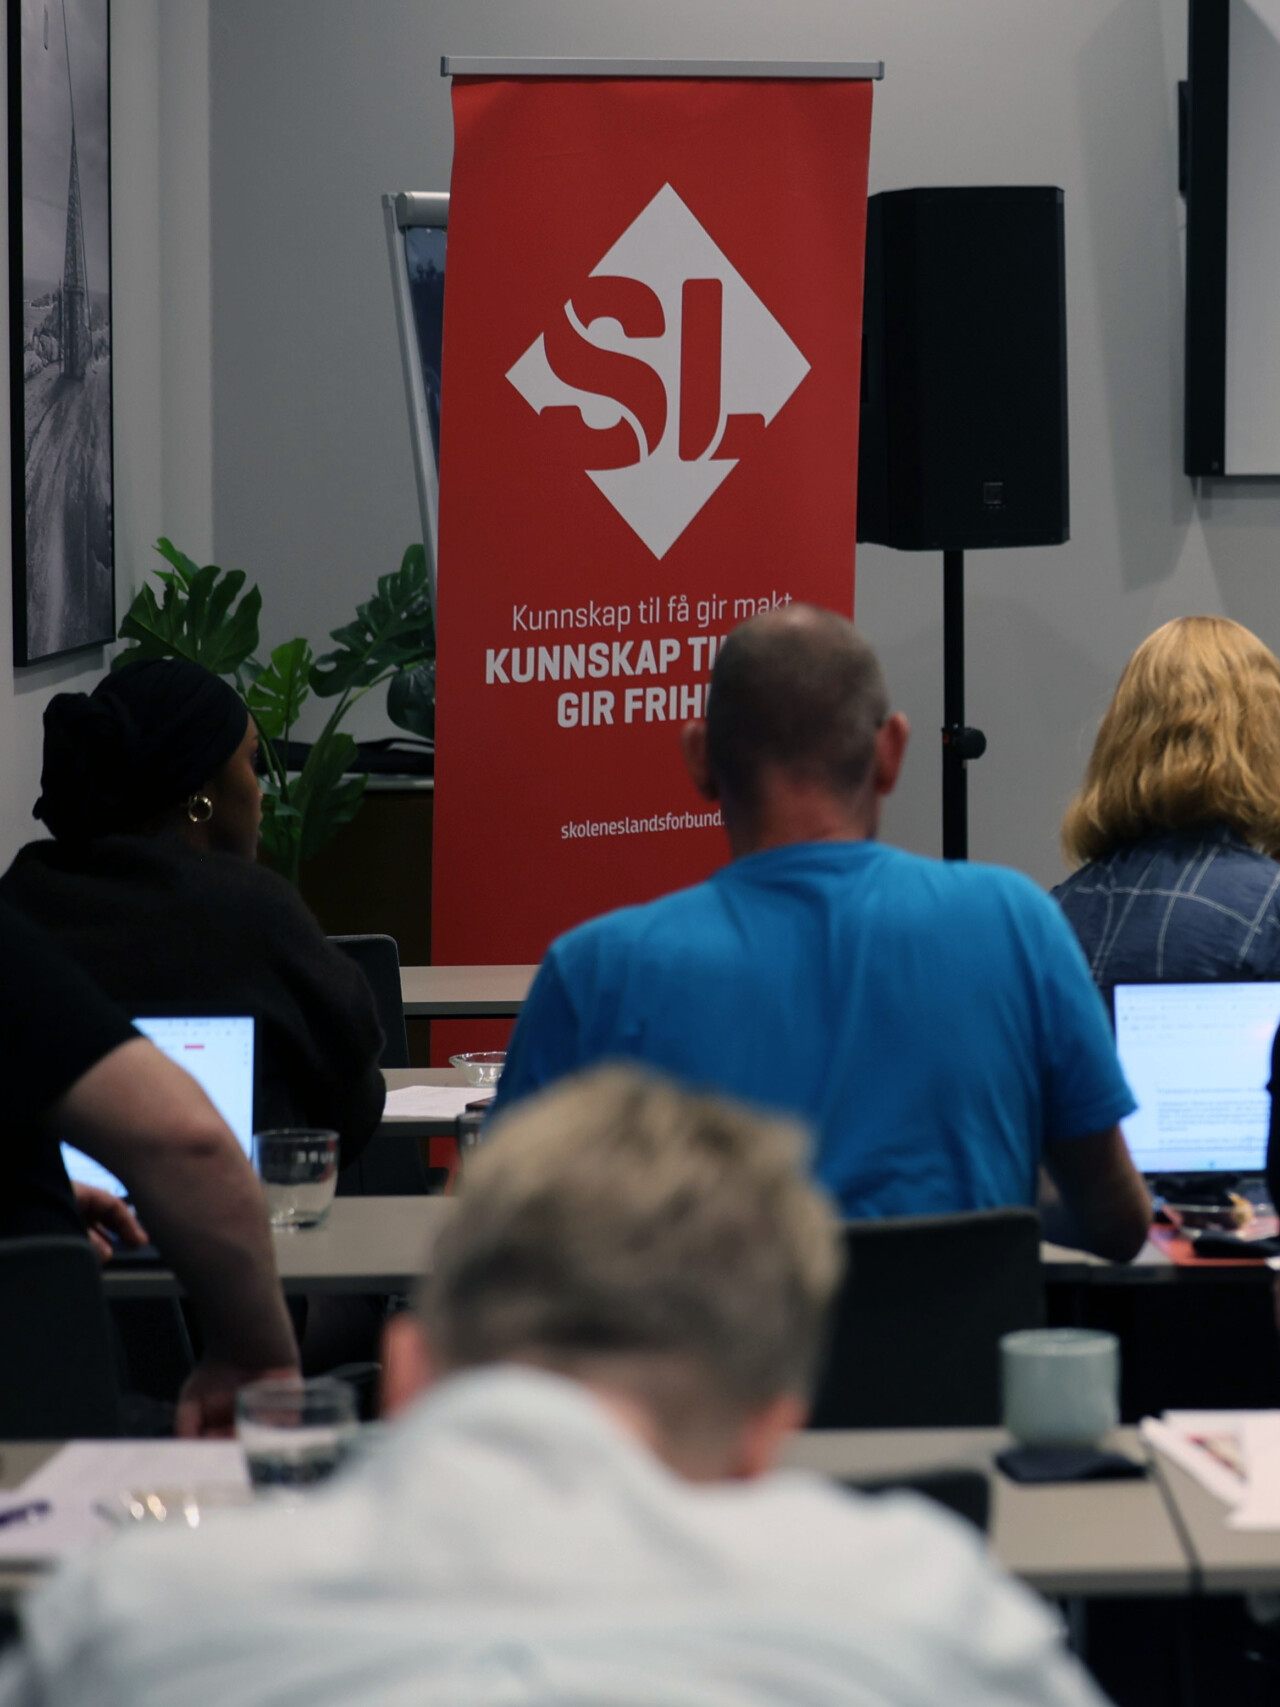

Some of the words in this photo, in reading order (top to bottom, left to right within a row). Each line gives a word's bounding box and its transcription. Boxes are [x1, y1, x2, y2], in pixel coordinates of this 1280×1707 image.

[512, 600, 631, 633] Kunnskap
[638, 596, 661, 624] til
[667, 594, 690, 623] få
[696, 593, 728, 628] gir
[485, 638, 681, 685] KUNNSKAP
[557, 690, 615, 728] GIR
